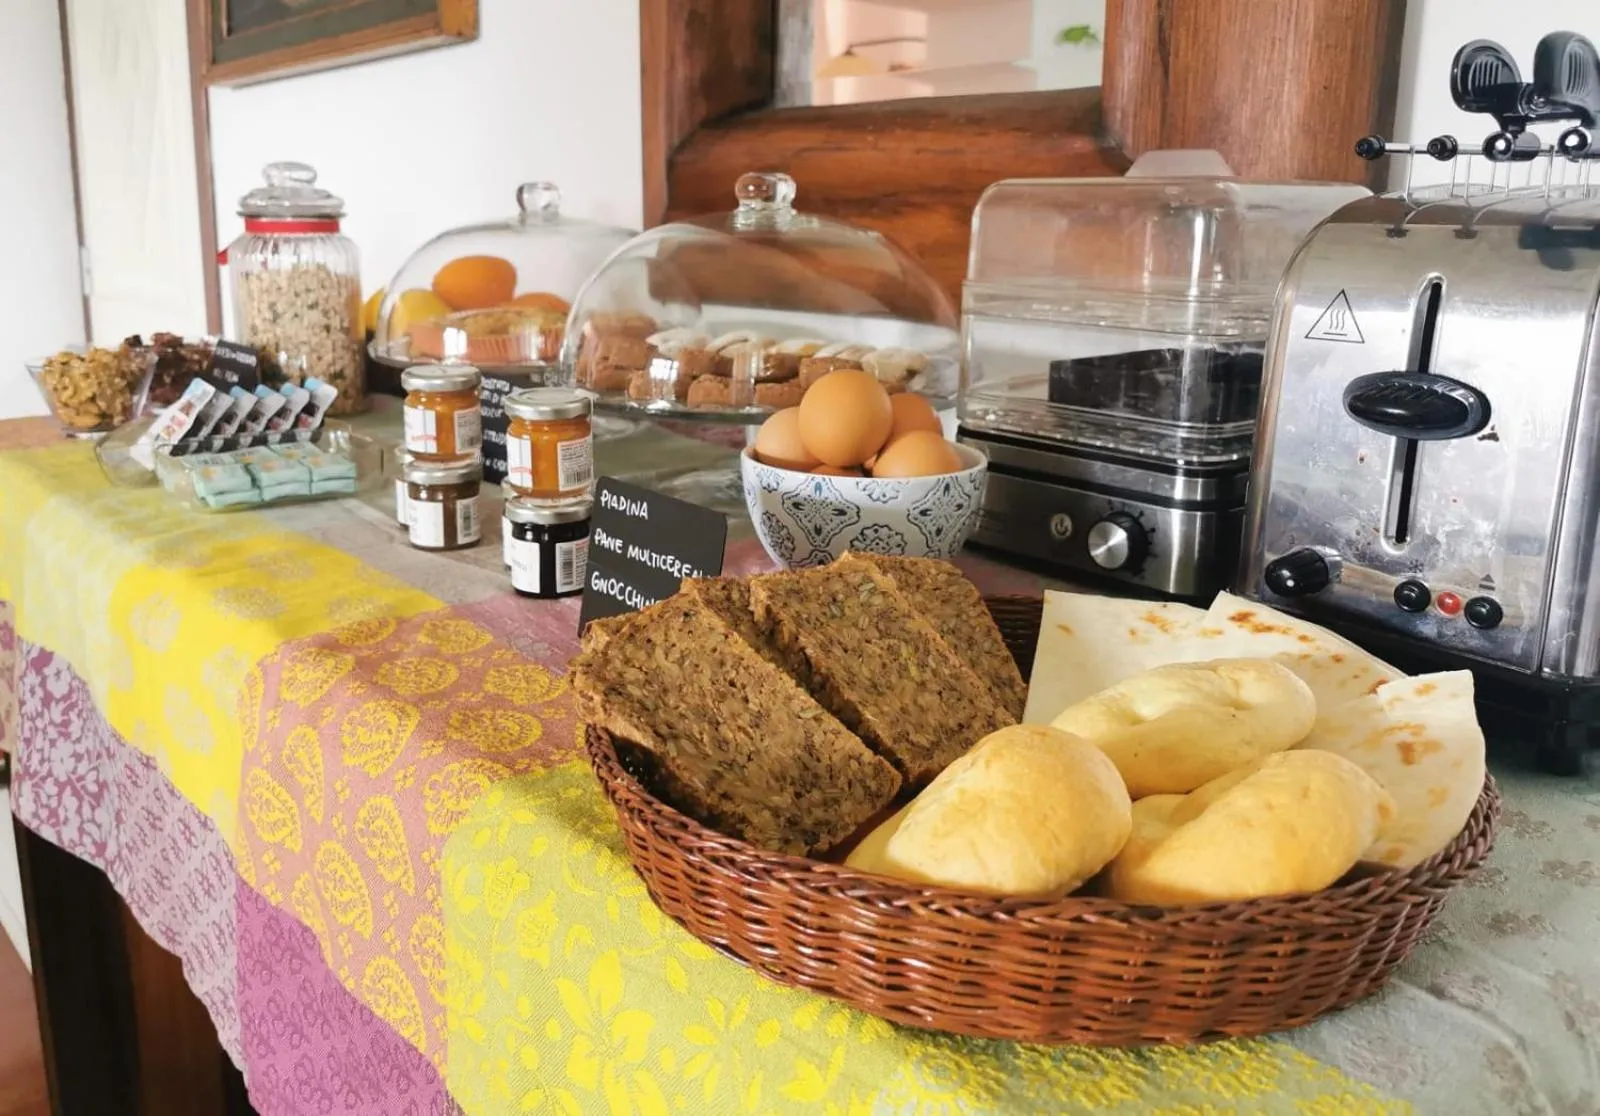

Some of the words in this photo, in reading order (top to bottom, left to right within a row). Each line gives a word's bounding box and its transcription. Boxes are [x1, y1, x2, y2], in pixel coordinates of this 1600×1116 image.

[600, 489, 649, 520] PIADINA
[594, 527, 624, 554] PANE
[627, 544, 711, 578] MULTICEREA
